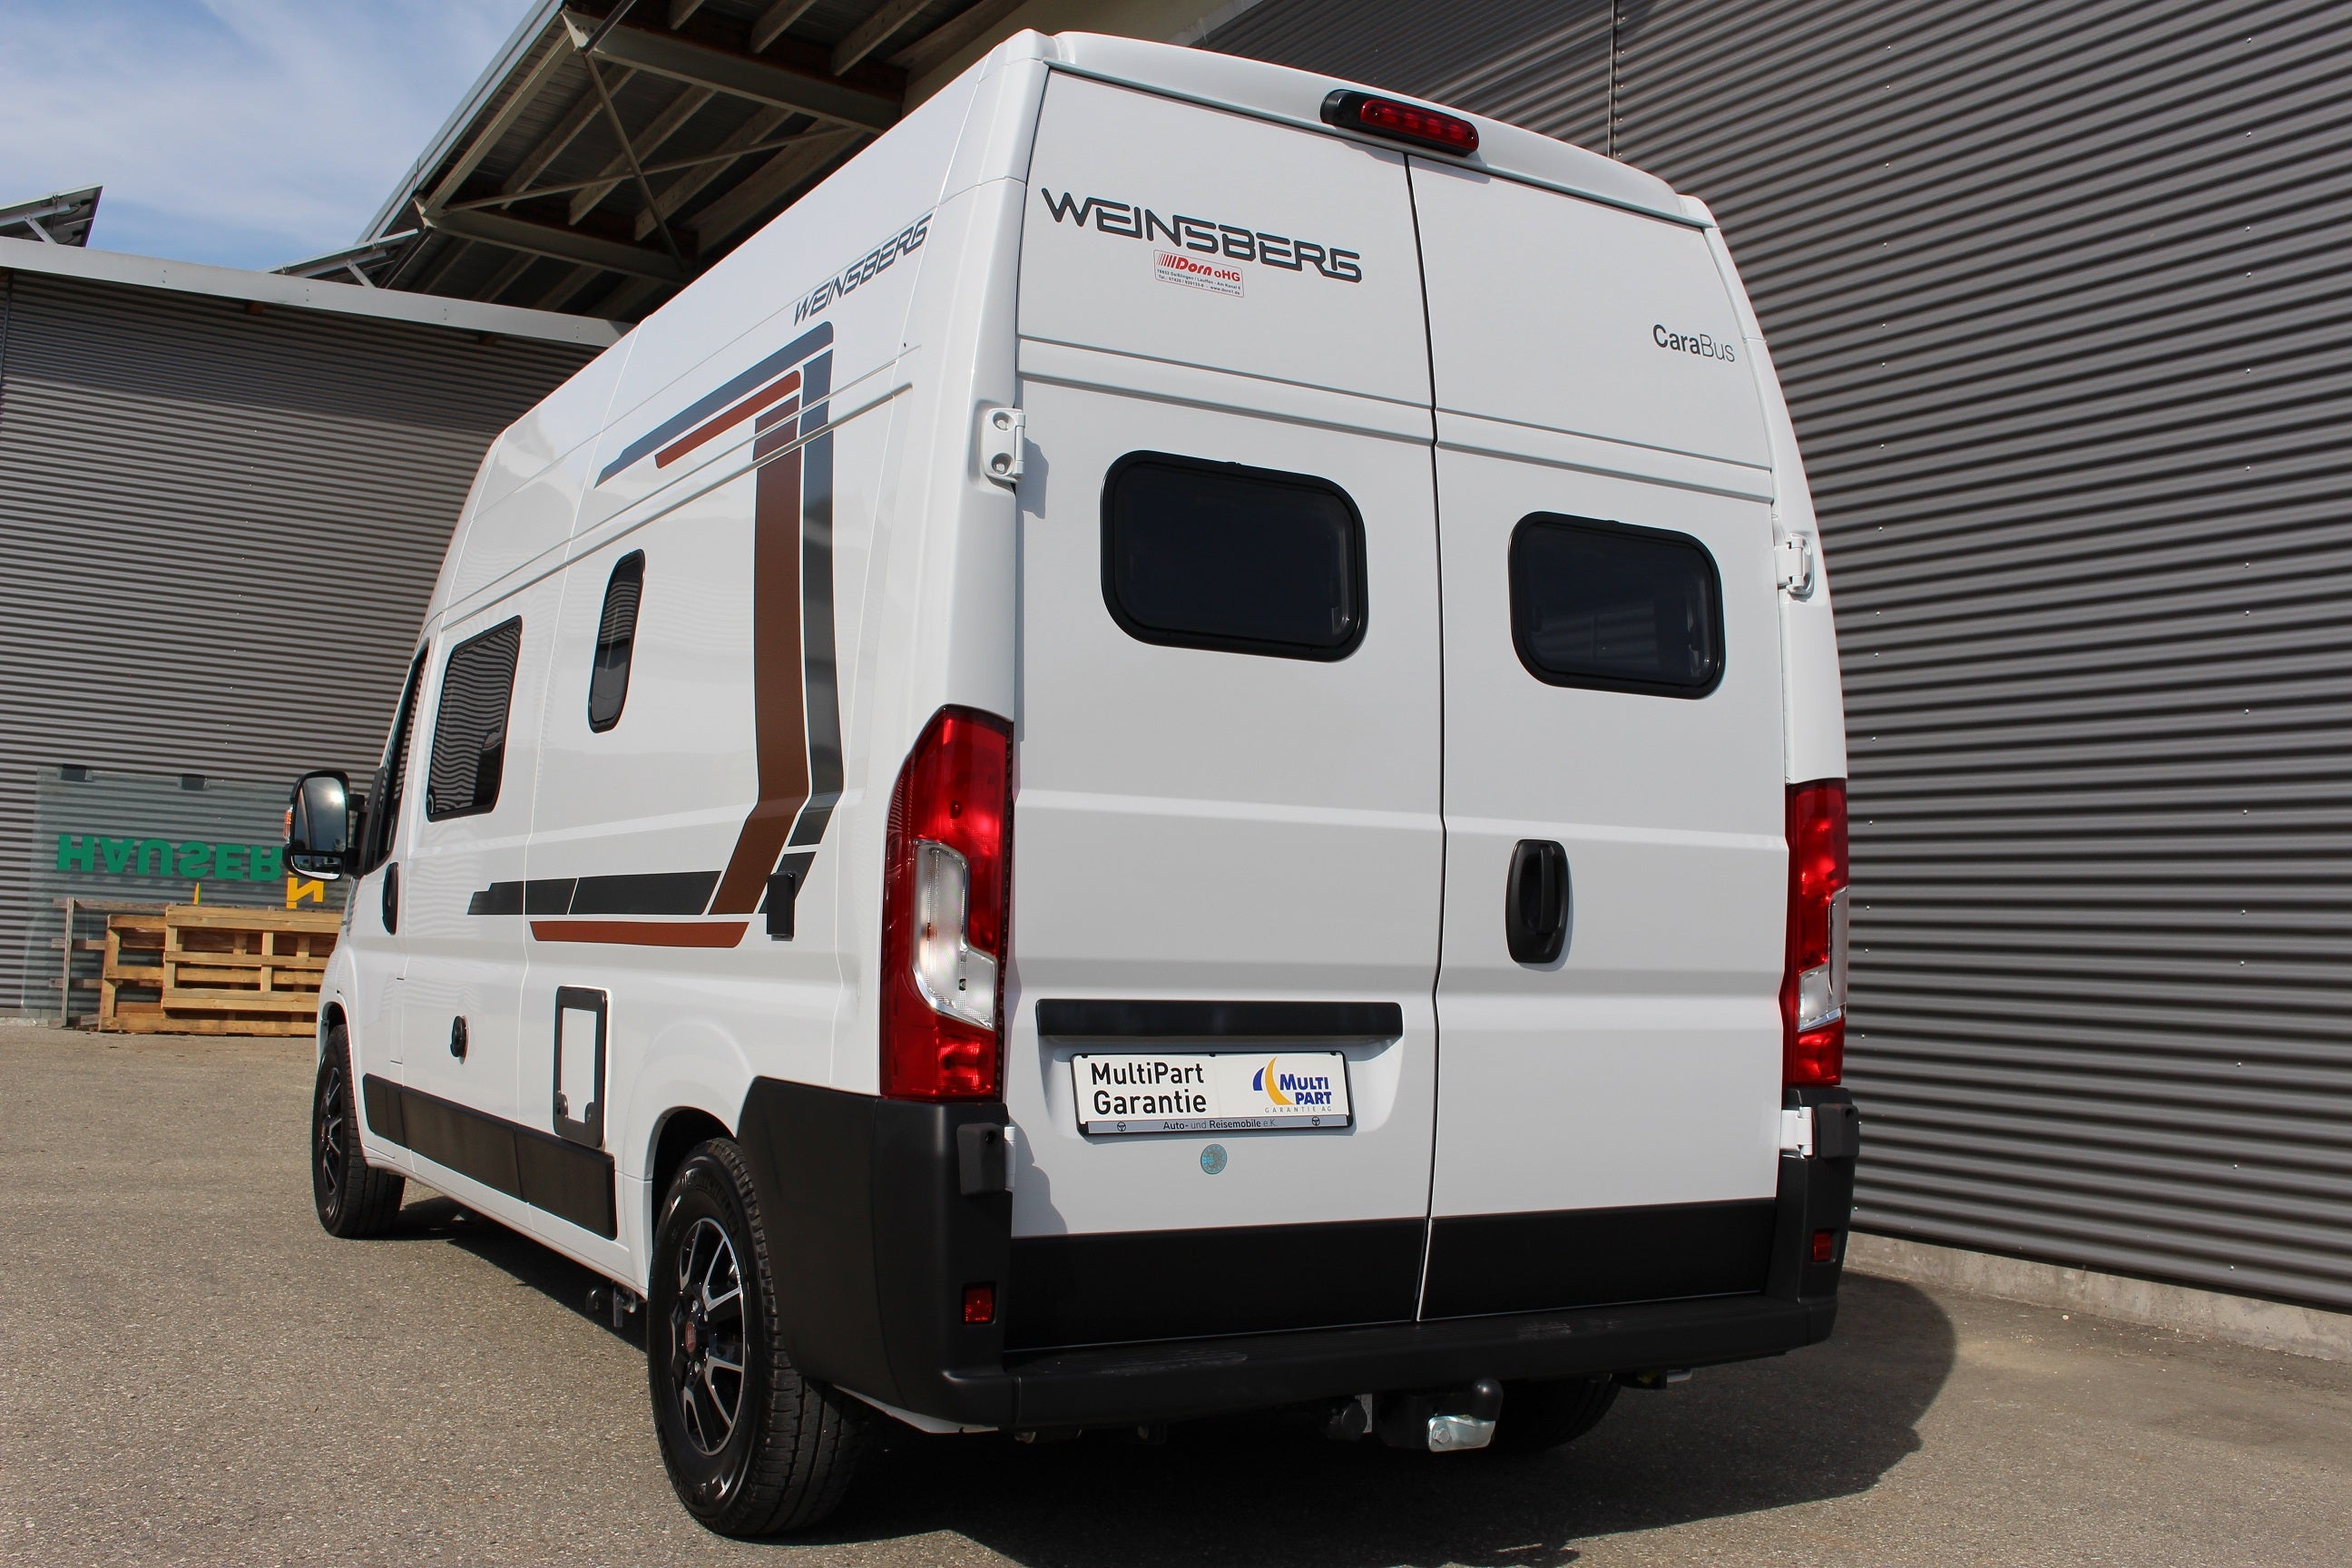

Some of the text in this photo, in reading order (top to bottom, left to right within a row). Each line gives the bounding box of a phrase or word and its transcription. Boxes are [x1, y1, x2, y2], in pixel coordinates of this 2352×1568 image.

[1041, 187, 1363, 284] WEINSBERG
[794, 212, 933, 327] WEINSBERG
[1175, 256, 1240, 282] Dorn oHG
[1652, 324, 1735, 363] CaraBus
[1091, 1062, 1204, 1085] MultiPart
[1279, 1073, 1329, 1091] MULTI
[1093, 1089, 1207, 1115] Garantie
[1295, 1092, 1332, 1105] PART
[1162, 1122, 1189, 1131] Auto-
[1191, 1121, 1207, 1130] und
[1209, 1119, 1261, 1129] Reisemobile
